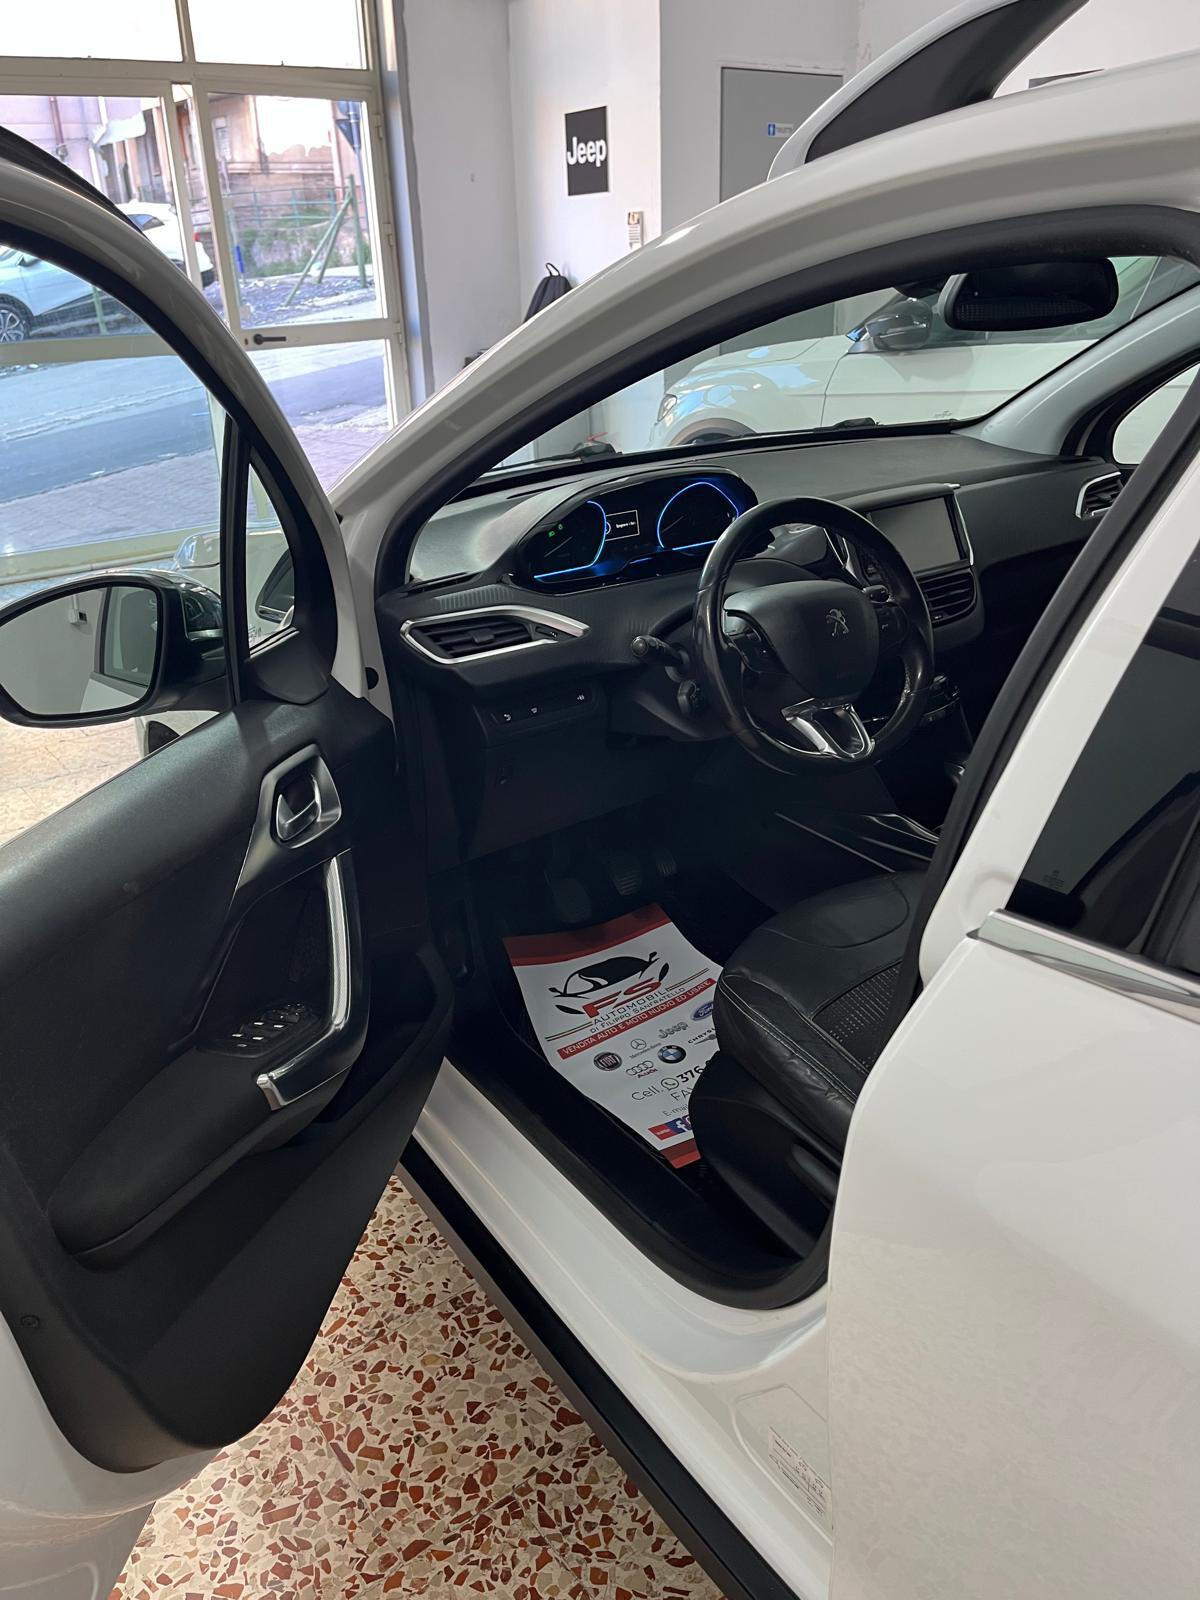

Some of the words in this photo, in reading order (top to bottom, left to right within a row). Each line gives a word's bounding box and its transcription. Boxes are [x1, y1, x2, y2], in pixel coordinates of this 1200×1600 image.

[567, 136, 607, 167] Jeep
[582, 977, 662, 1018] FS
[590, 1026, 600, 1034] DI
[600, 1012, 631, 1029] FILIPPO
[632, 987, 686, 1014] SANFRATELLO
[594, 987, 670, 1025] AUTOMOBILI
[562, 1037, 597, 1055] VENDITA
[597, 1028, 619, 1040] AUTO
[626, 1013, 648, 1026] MOTO
[648, 1000, 676, 1016] NUOVO
[675, 993, 687, 1003] ED
[686, 981, 711, 996] USATE
[658, 1021, 689, 1039] Jeep
